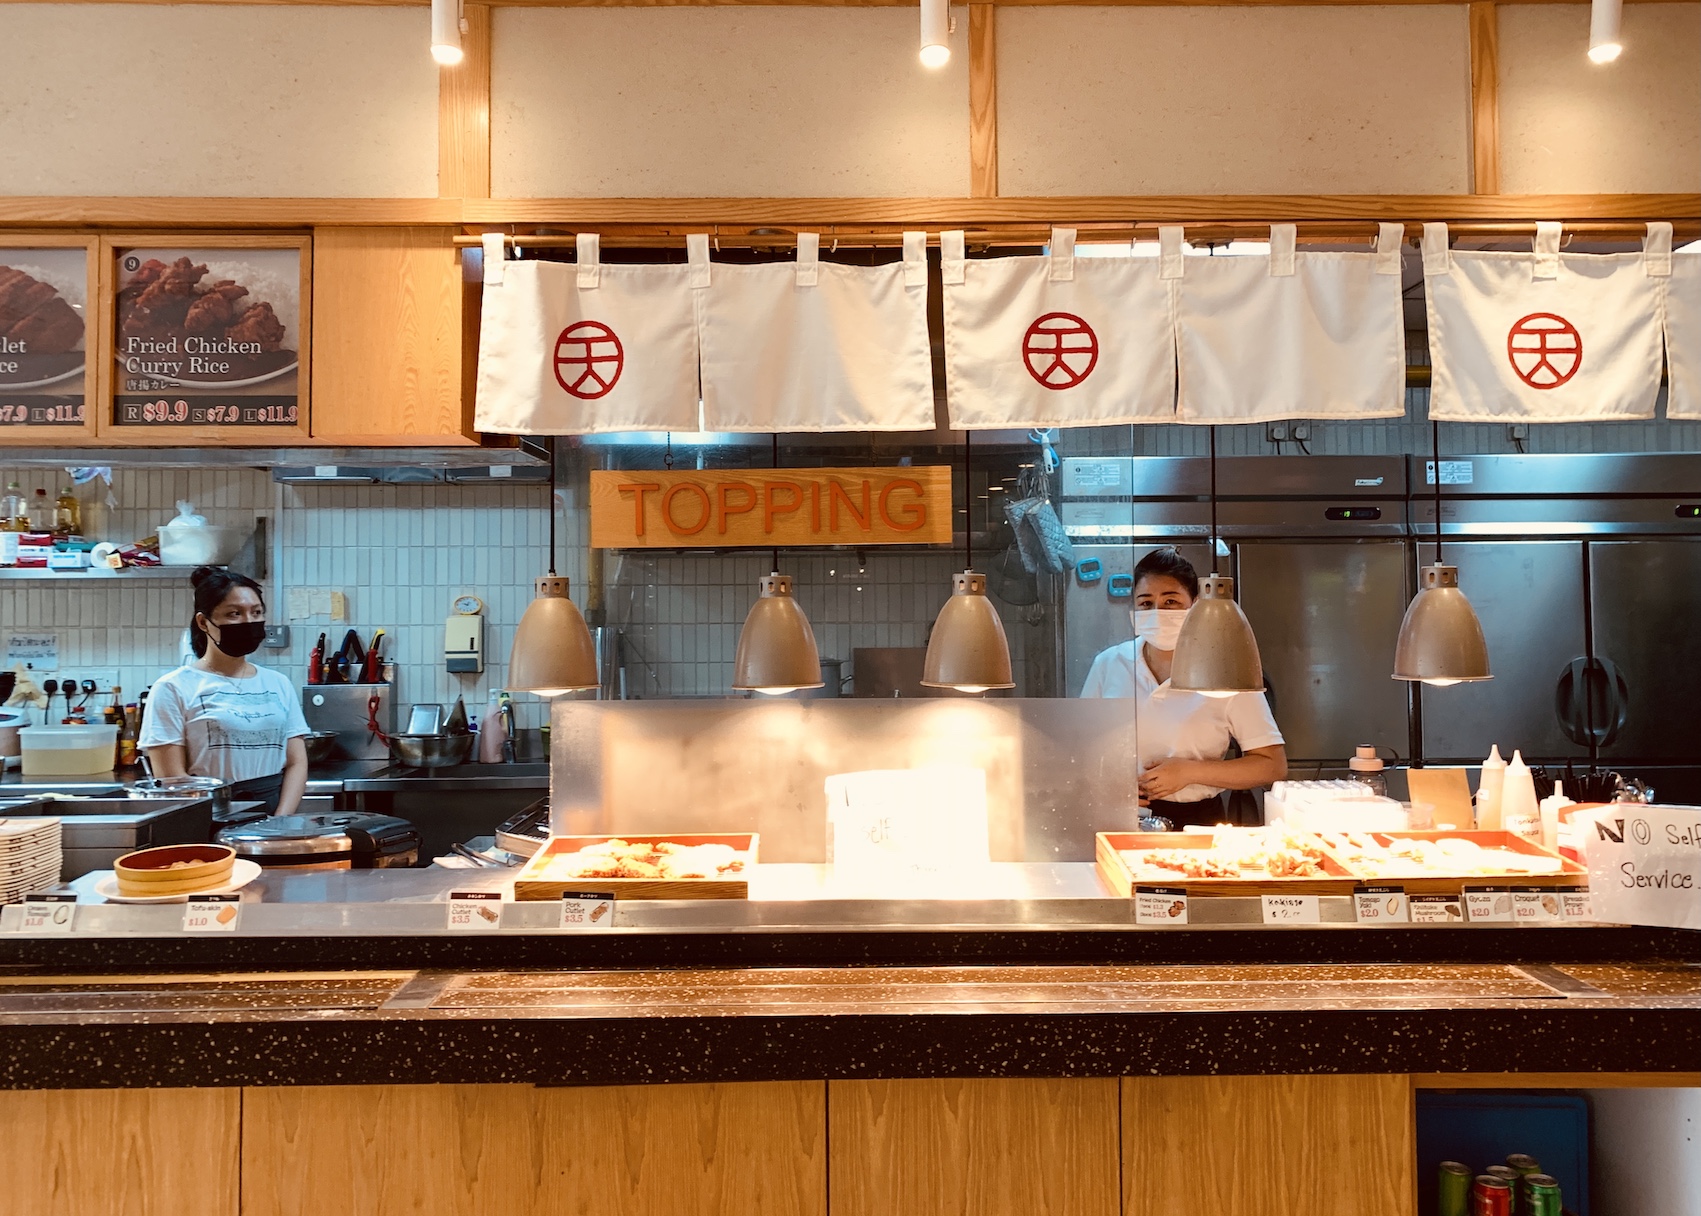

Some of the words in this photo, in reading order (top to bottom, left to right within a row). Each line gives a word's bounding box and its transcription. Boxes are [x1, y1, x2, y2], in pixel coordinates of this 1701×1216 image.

[0, 336, 27, 353] let
[126, 337, 178, 354] Fried
[184, 337, 262, 354] Chicken
[126, 357, 183, 377] Curry
[189, 357, 230, 373] Rice
[143, 400, 189, 422] $9.9
[206, 405, 240, 422] $7.9
[257, 405, 298, 422] $11.9
[618, 480, 926, 537] TOPPING
[1594, 818, 1651, 845] NO
[1665, 823, 1701, 848] Self
[564, 914, 583, 923] $3.5
[1361, 909, 1379, 918] $2.0
[1472, 908, 1490, 917] $2.0
[1517, 908, 1535, 917] $2.0
[188, 917, 208, 926] $1.0
[451, 915, 470, 924] $3.5
